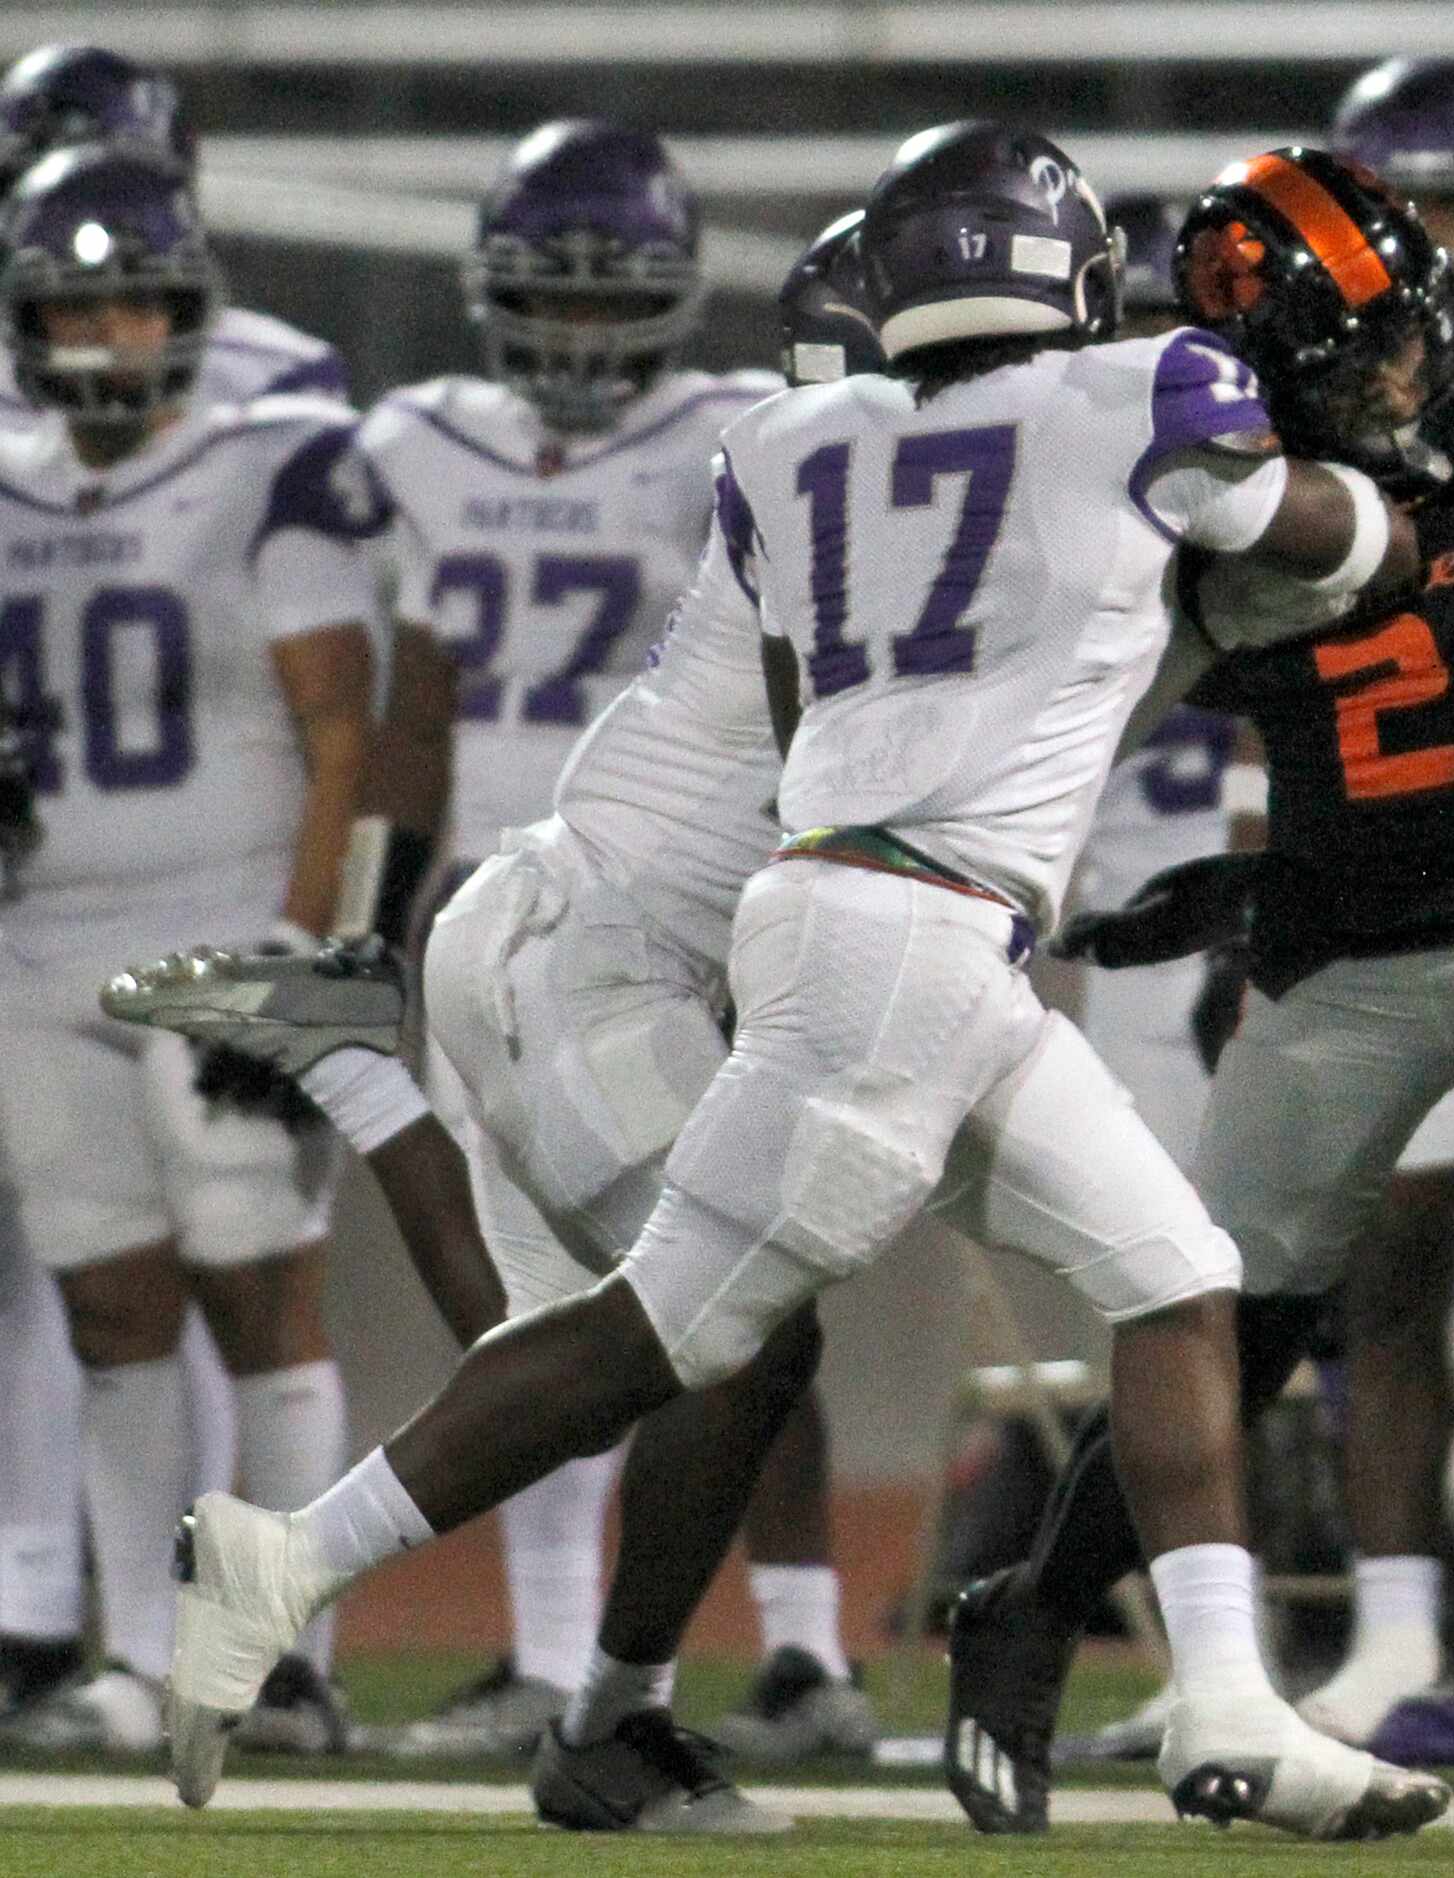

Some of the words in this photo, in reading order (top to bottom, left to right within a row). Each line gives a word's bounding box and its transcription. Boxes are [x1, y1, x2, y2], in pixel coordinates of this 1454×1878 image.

[957, 227, 988, 260] 17
[427, 552, 643, 728] 27
[796, 424, 1018, 700] 17
